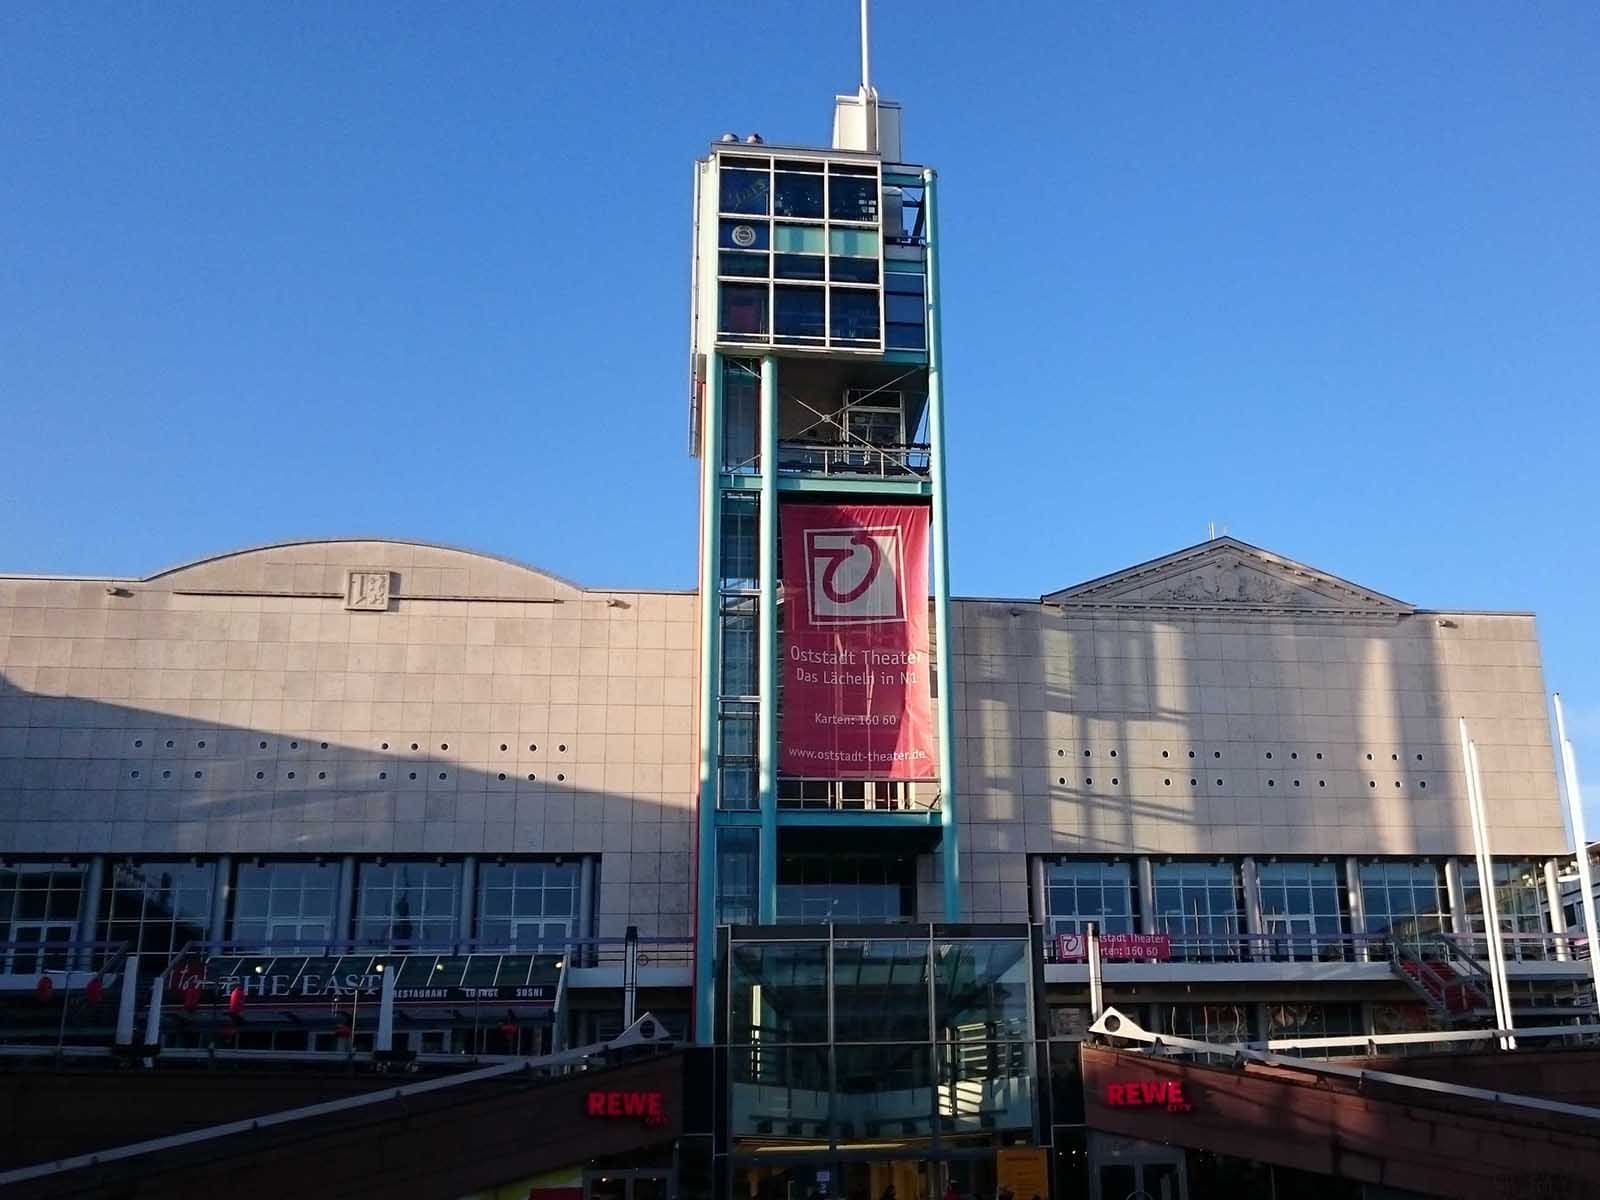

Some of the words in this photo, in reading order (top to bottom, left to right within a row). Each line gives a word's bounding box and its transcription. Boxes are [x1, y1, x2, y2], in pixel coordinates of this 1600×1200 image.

[790, 645, 856, 665] Oststadt
[862, 649, 922, 665] Theater
[796, 667, 818, 683] Das
[823, 670, 875, 685] Lächeln
[881, 671, 895, 685] in
[815, 712, 856, 725] Karten:
[859, 714, 879, 725] 160
[882, 714, 897, 725] 60
[789, 746, 926, 762] www.oststadt-theater.de
[1100, 933, 1127, 943] tstadt
[1130, 933, 1164, 944] Theater
[1101, 946, 1123, 957] rten:
[1126, 946, 1143, 956] 160
[1146, 947, 1158, 956] 60
[218, 975, 290, 996] THE
[299, 974, 382, 996] EAST
[393, 988, 448, 998] RESTAURANT
[516, 988, 543, 998] SUSHI
[1107, 1080, 1183, 1104] REWE
[587, 1091, 664, 1116] REWE
